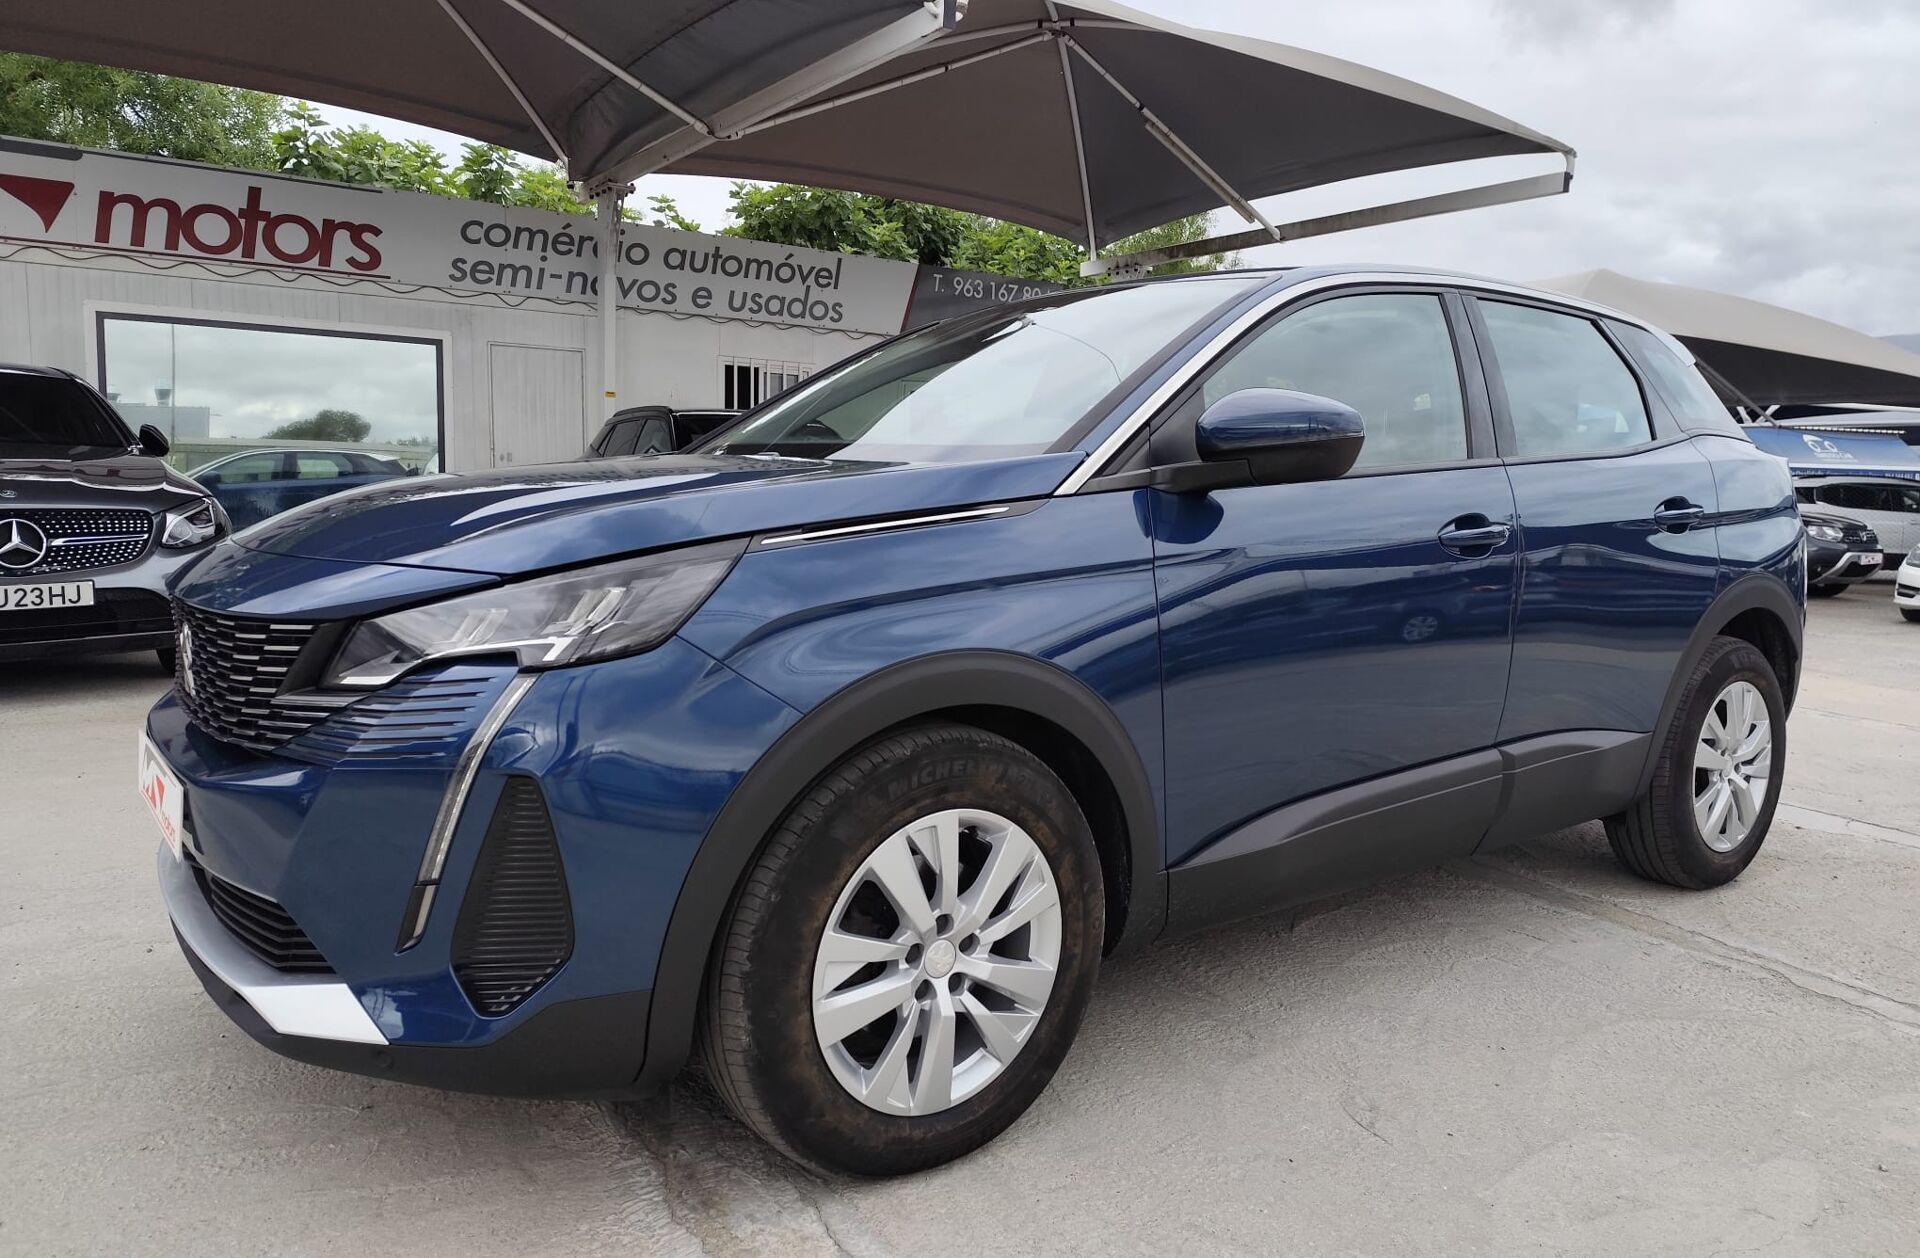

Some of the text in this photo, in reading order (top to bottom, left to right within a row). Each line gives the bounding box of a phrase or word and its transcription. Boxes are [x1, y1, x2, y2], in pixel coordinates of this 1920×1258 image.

[95, 186, 383, 271] motors
[460, 219, 843, 289] comério automóvel
[691, 285, 713, 309] e
[728, 286, 844, 323] usados
[932, 273, 945, 294] T.
[953, 276, 983, 299] 963
[989, 281, 1019, 303] 167
